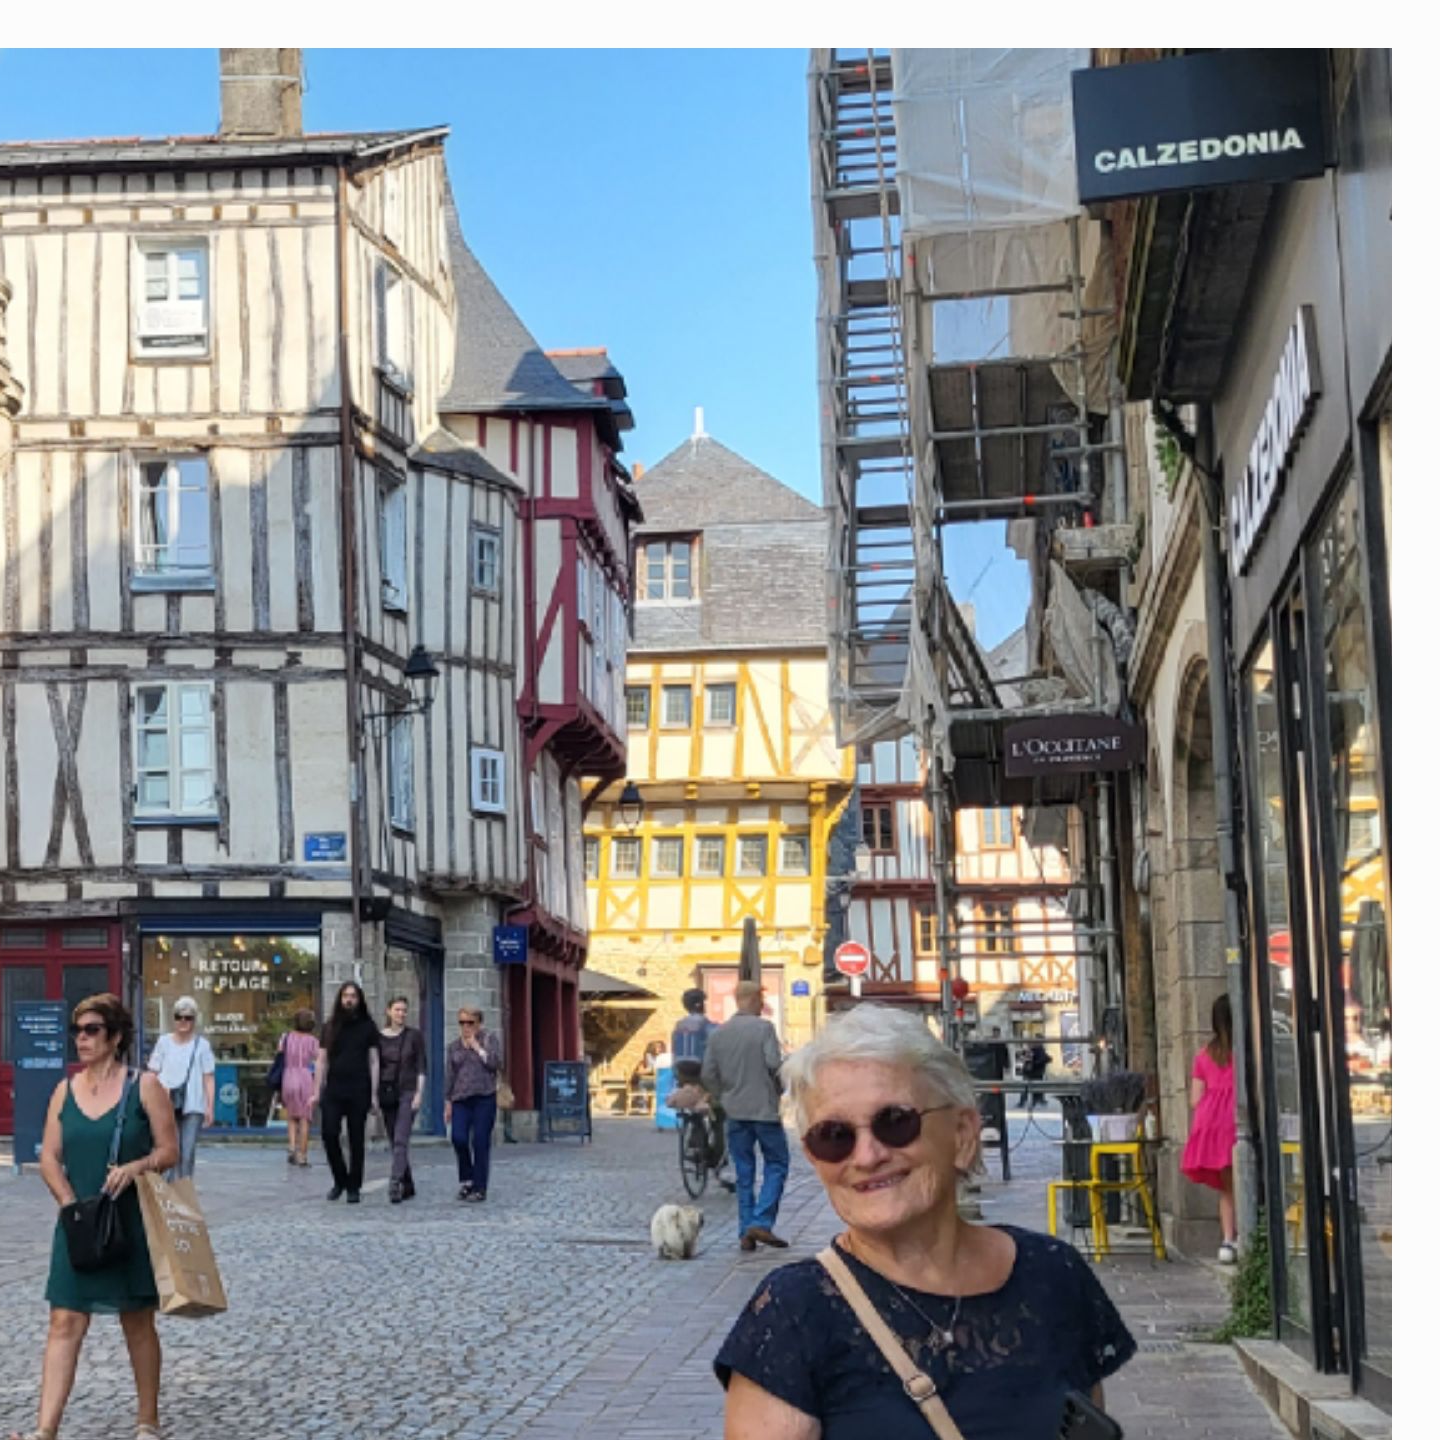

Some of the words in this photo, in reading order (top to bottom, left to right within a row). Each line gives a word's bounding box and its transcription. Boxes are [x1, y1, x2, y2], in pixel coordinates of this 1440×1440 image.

[1094, 127, 1305, 174] CALZEDONIA
[1011, 736, 1122, 758] L'OCCITANE
[199, 959, 266, 972] RETOUR
[193, 976, 214, 990] DE
[219, 976, 271, 990] PLAGE
